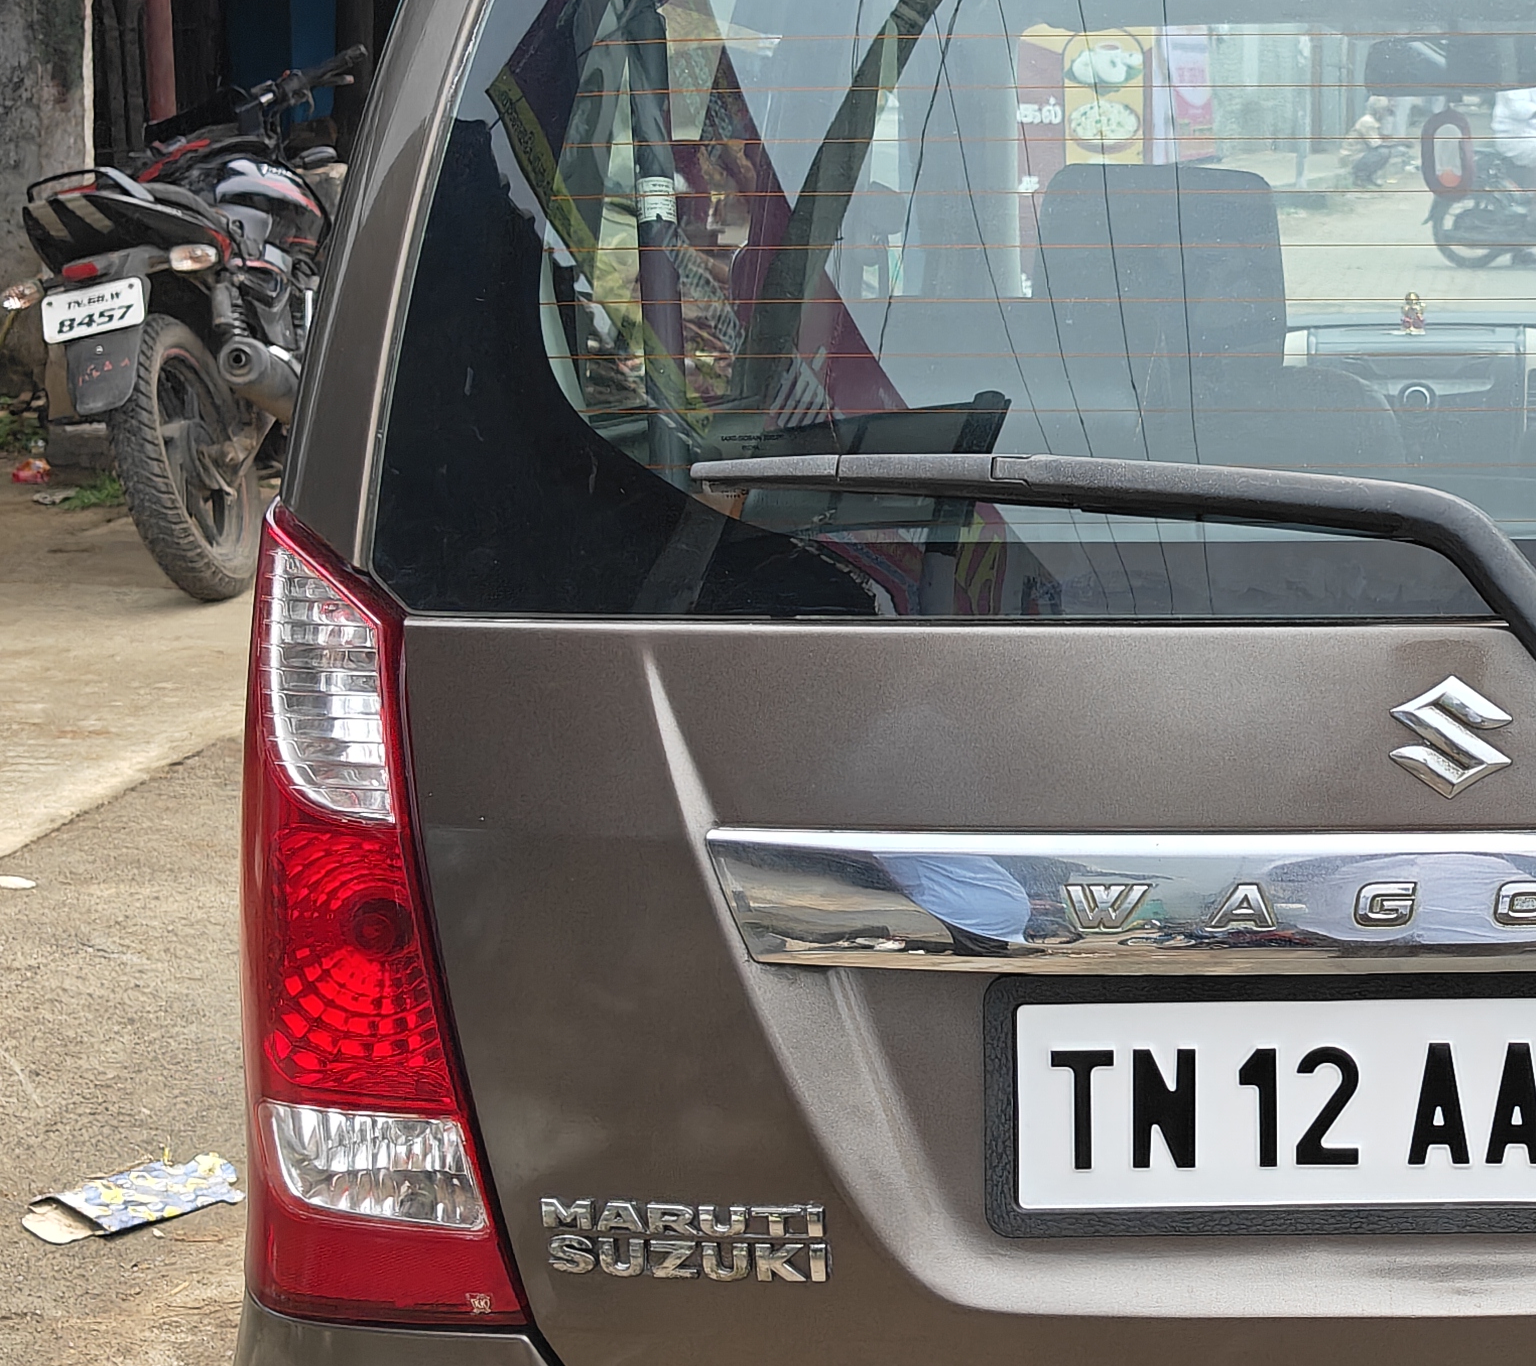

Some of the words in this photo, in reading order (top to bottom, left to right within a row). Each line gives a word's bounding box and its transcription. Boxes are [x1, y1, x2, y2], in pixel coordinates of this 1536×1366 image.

[57, 304, 133, 334] 8457
[1050, 1047, 1196, 1170] TN
[1238, 1047, 1359, 1166] 12
[540, 1196, 826, 1238] MARUTI
[549, 1235, 830, 1283] SUZUKI
